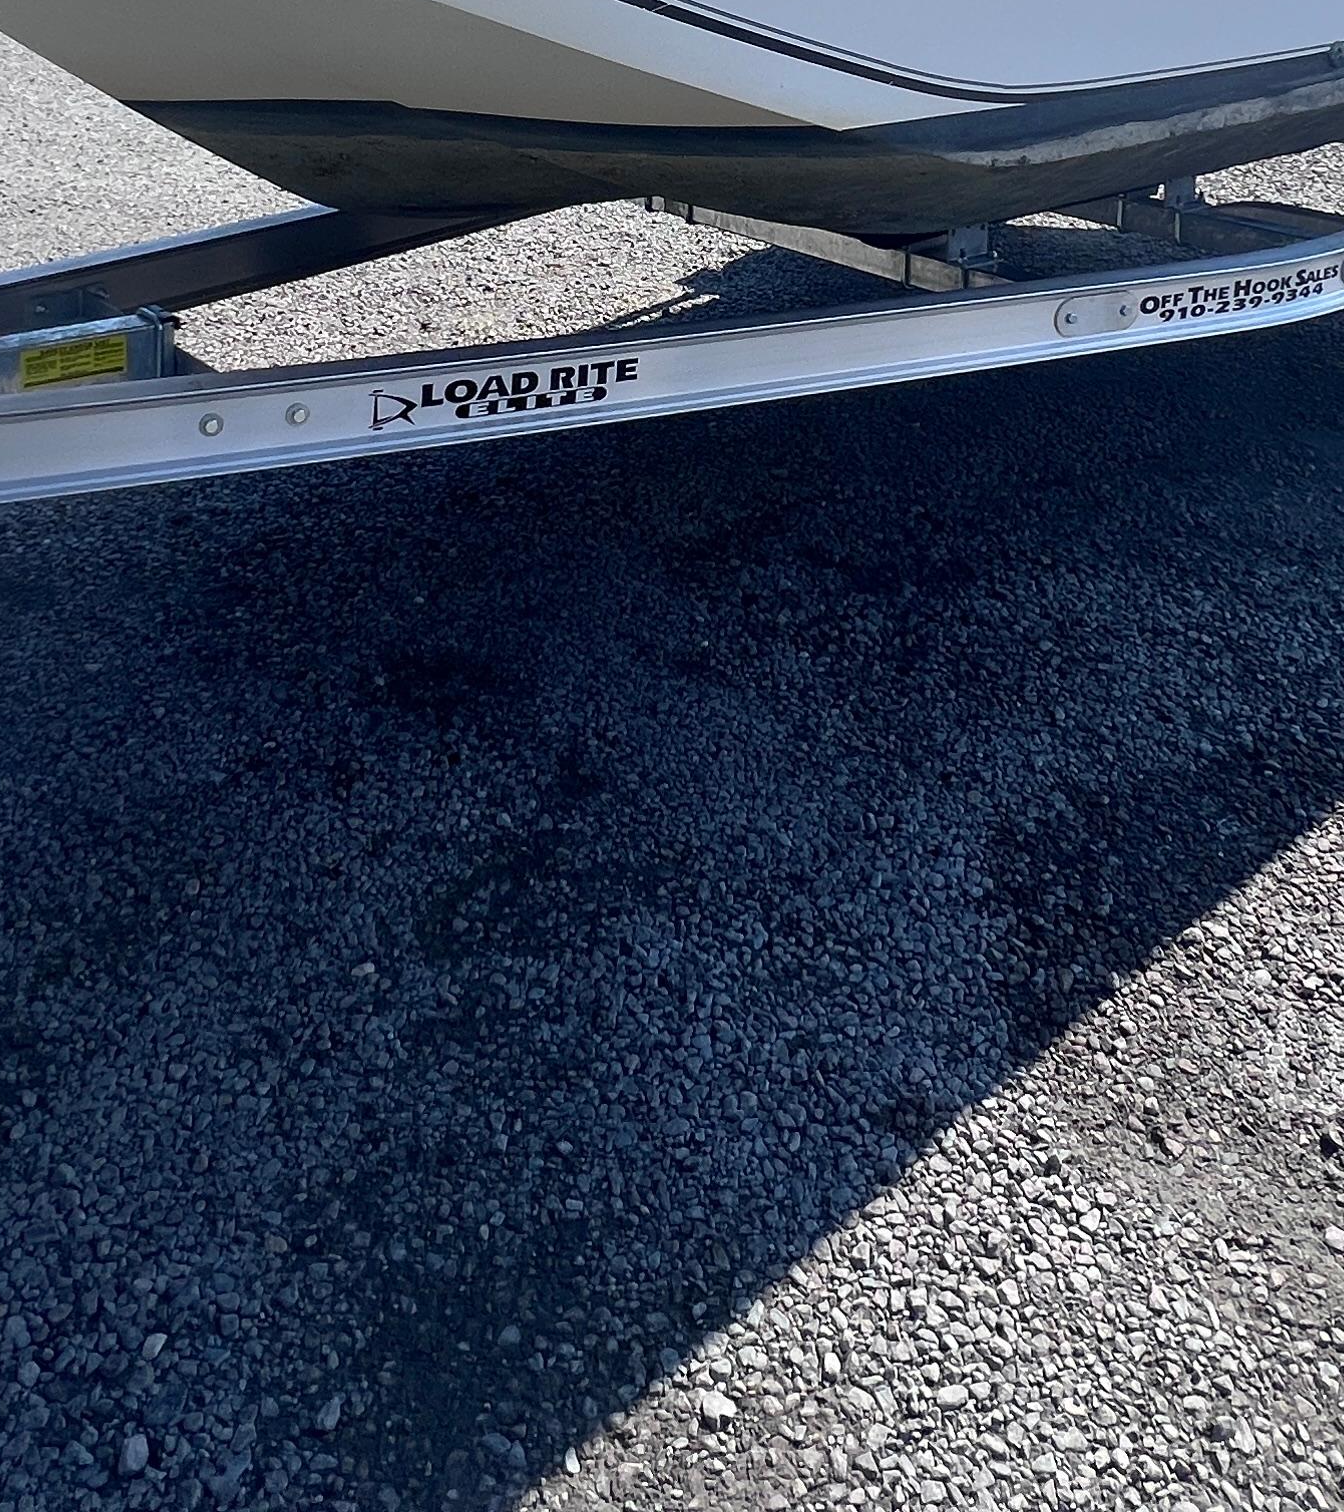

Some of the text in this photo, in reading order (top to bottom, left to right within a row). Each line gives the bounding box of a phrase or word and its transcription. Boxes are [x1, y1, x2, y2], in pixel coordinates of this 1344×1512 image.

[1140, 264, 1340, 315] OFF THE HOOK SALES
[1159, 282, 1324, 323] 910-239-9344
[421, 358, 639, 408] LOAD RITE
[468, 387, 596, 417] ELITE
